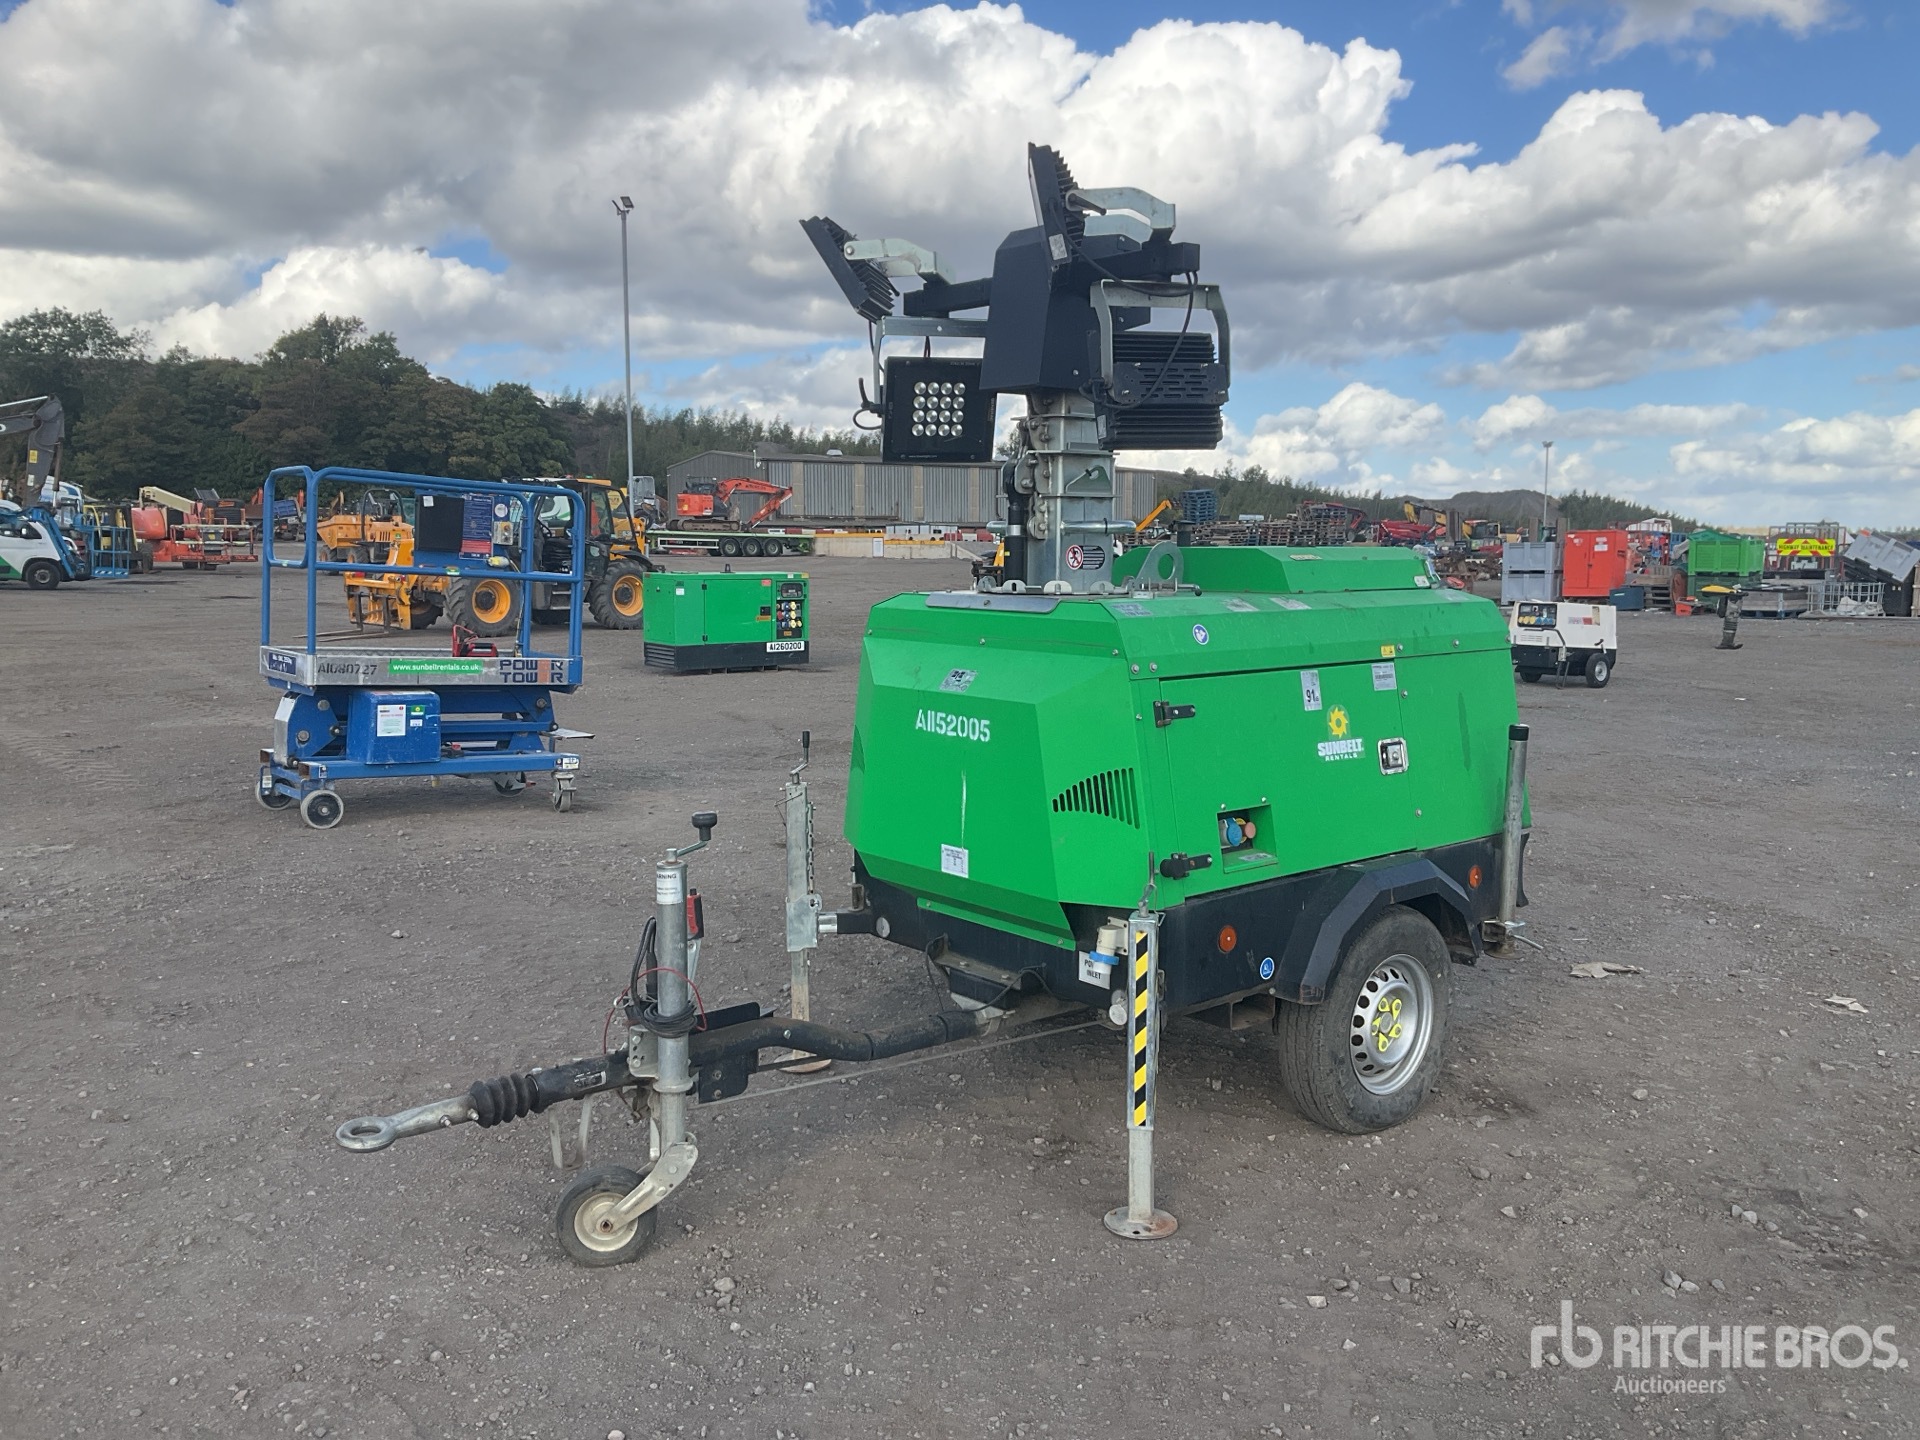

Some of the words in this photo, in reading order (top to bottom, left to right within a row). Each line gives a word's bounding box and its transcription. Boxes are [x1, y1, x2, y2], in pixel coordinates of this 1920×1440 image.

[500, 659, 564, 671] POWR
[500, 672, 564, 683] TOWR
[1317, 738, 1363, 757] SUNBELT
[1325, 752, 1358, 762] RENTALS
[1086, 970, 1101, 980] INLET
